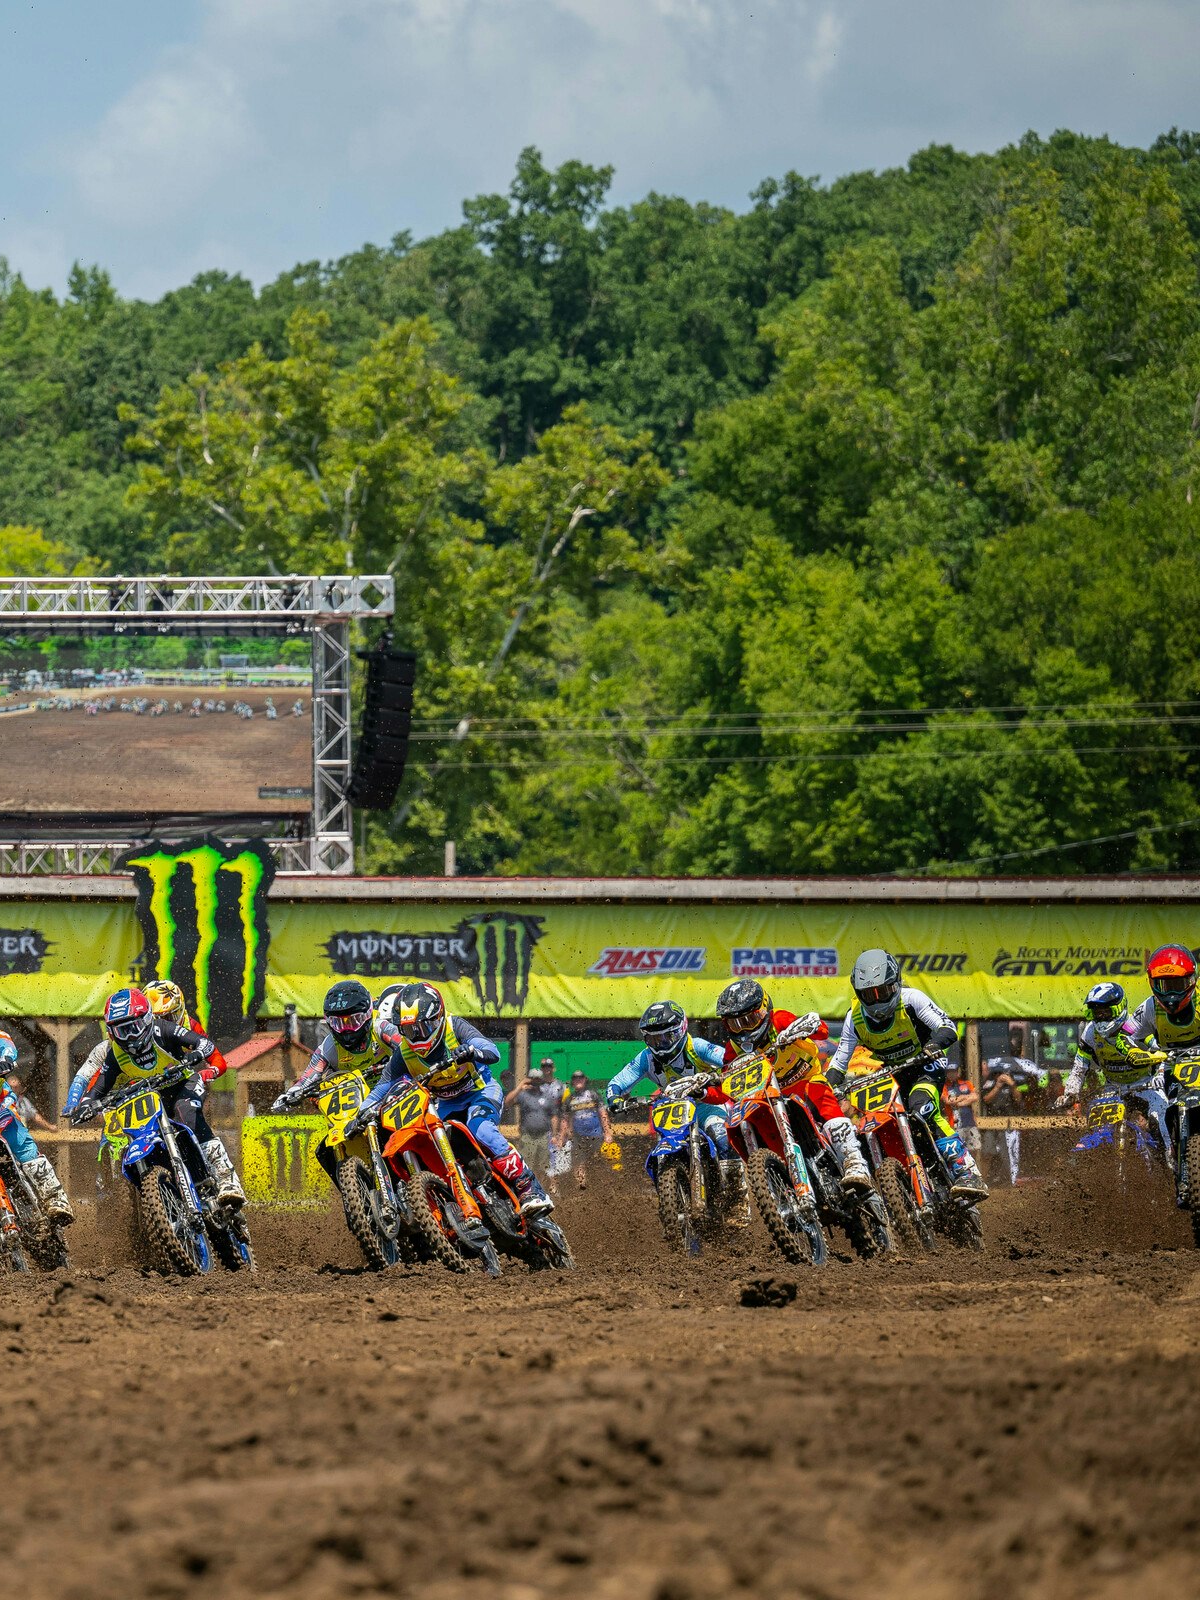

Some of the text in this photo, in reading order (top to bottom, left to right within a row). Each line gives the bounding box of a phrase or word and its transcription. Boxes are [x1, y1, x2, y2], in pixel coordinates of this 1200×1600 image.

[337, 937, 467, 959] MONSTER
[733, 949, 837, 965] PARTS
[1017, 946, 1141, 958] ROCKY MOUNTAIN
[356, 962, 446, 972] ENERGY
[596, 949, 706, 974] AMSOIL
[733, 965, 837, 976] UNLIMITED
[896, 953, 969, 972] THOR
[730, 1064, 763, 1099] 93
[327, 1087, 361, 1115] 43
[855, 1080, 892, 1112] 15
[118, 1097, 156, 1128] 70
[390, 1095, 422, 1129] 12
[654, 1104, 688, 1128] 79
[177, 1169, 194, 1208] DUNLOP
[374, 1164, 390, 1201] DUNLOP
